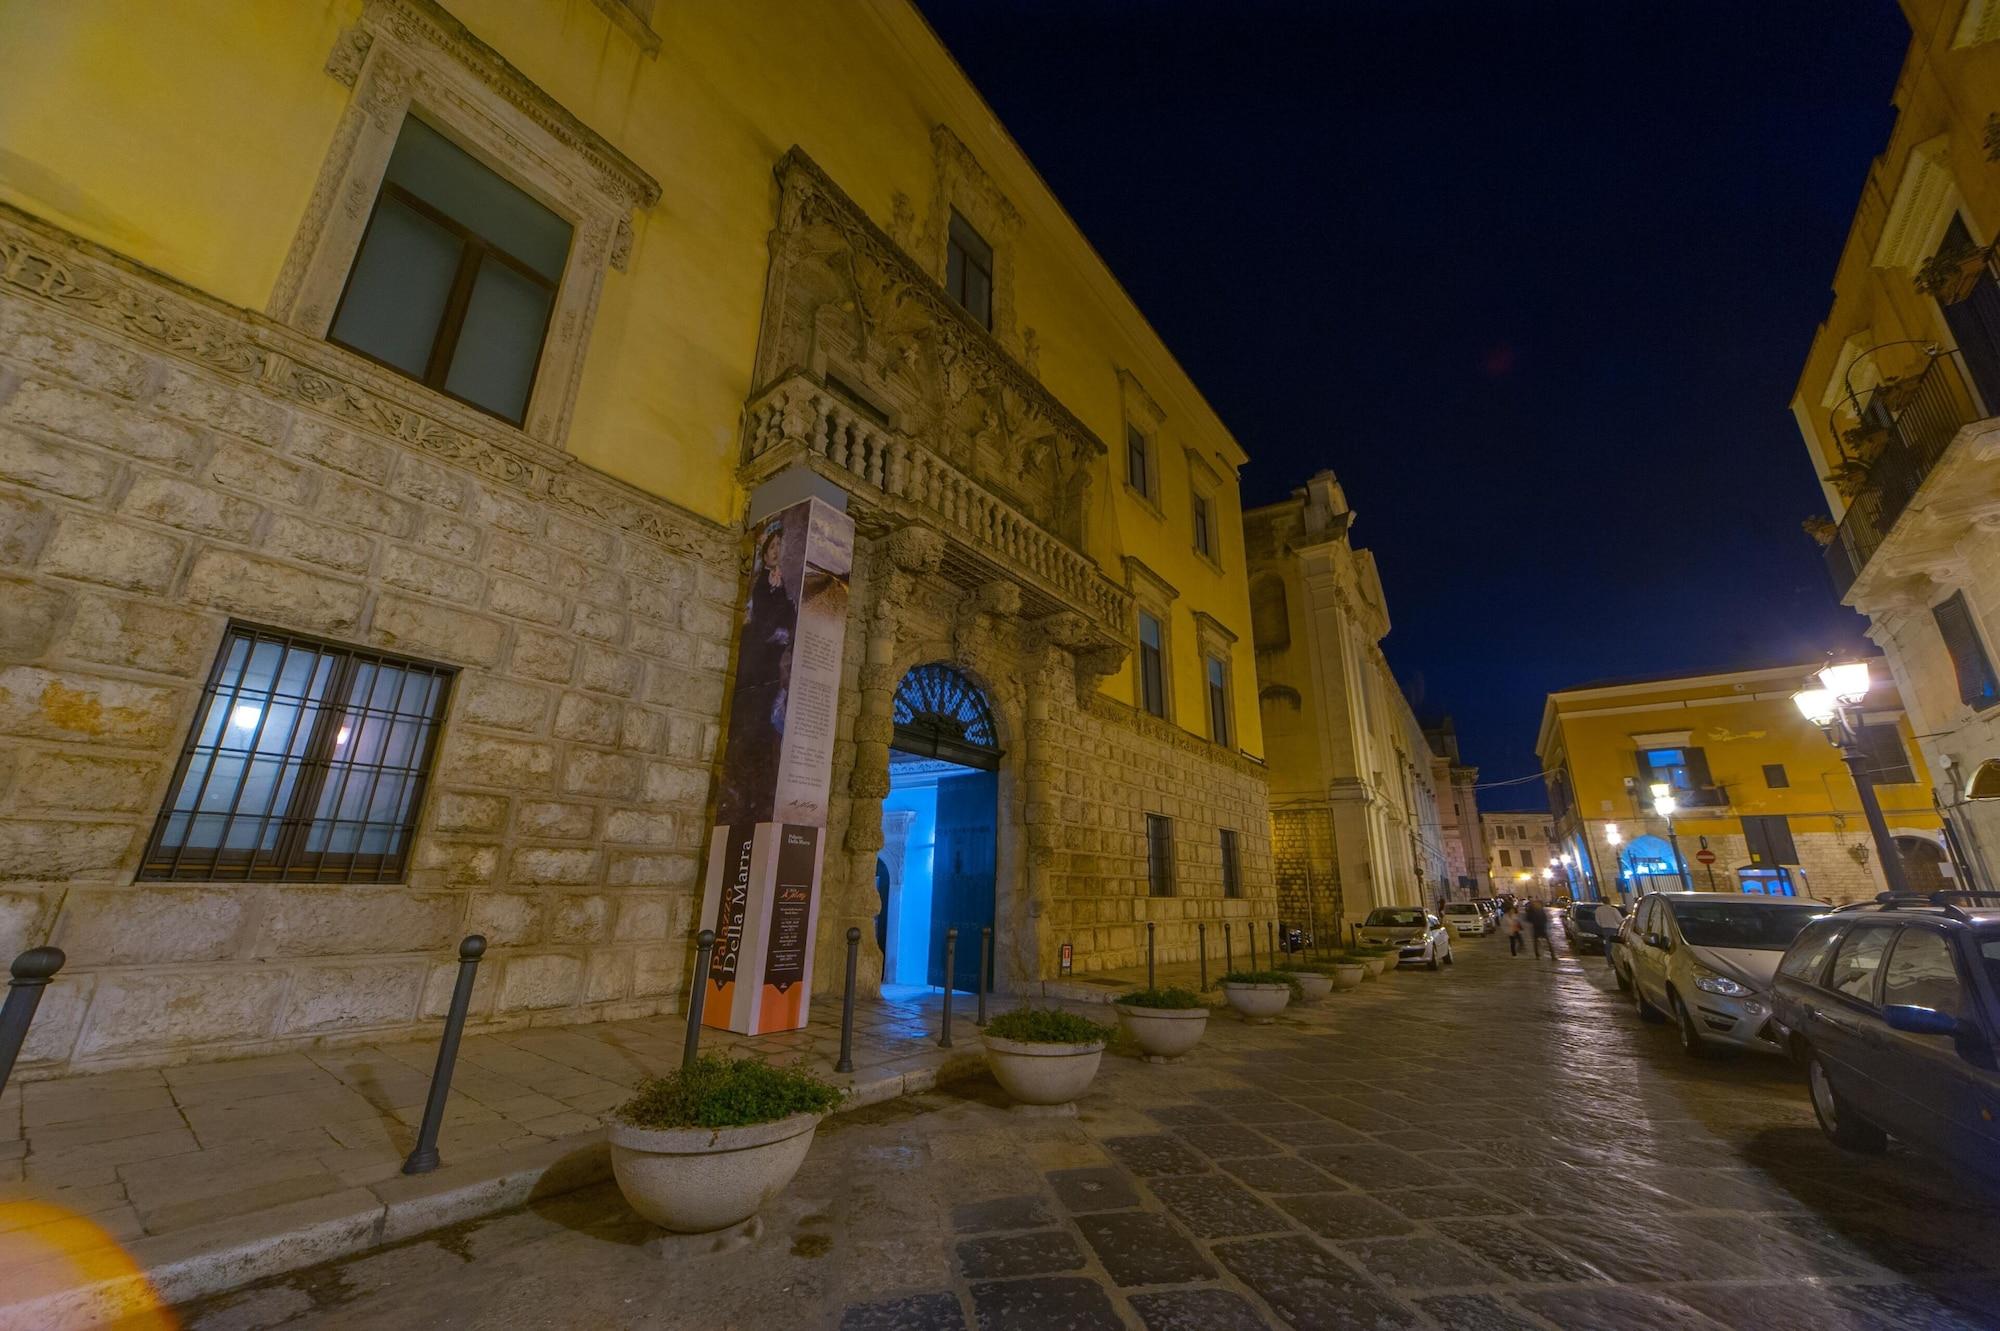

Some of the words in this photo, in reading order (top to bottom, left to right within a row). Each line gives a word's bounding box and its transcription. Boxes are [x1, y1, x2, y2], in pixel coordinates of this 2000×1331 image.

[731, 840, 752, 905] Marra
[712, 887, 733, 970] Palazzo
[723, 913, 744, 974] Della
